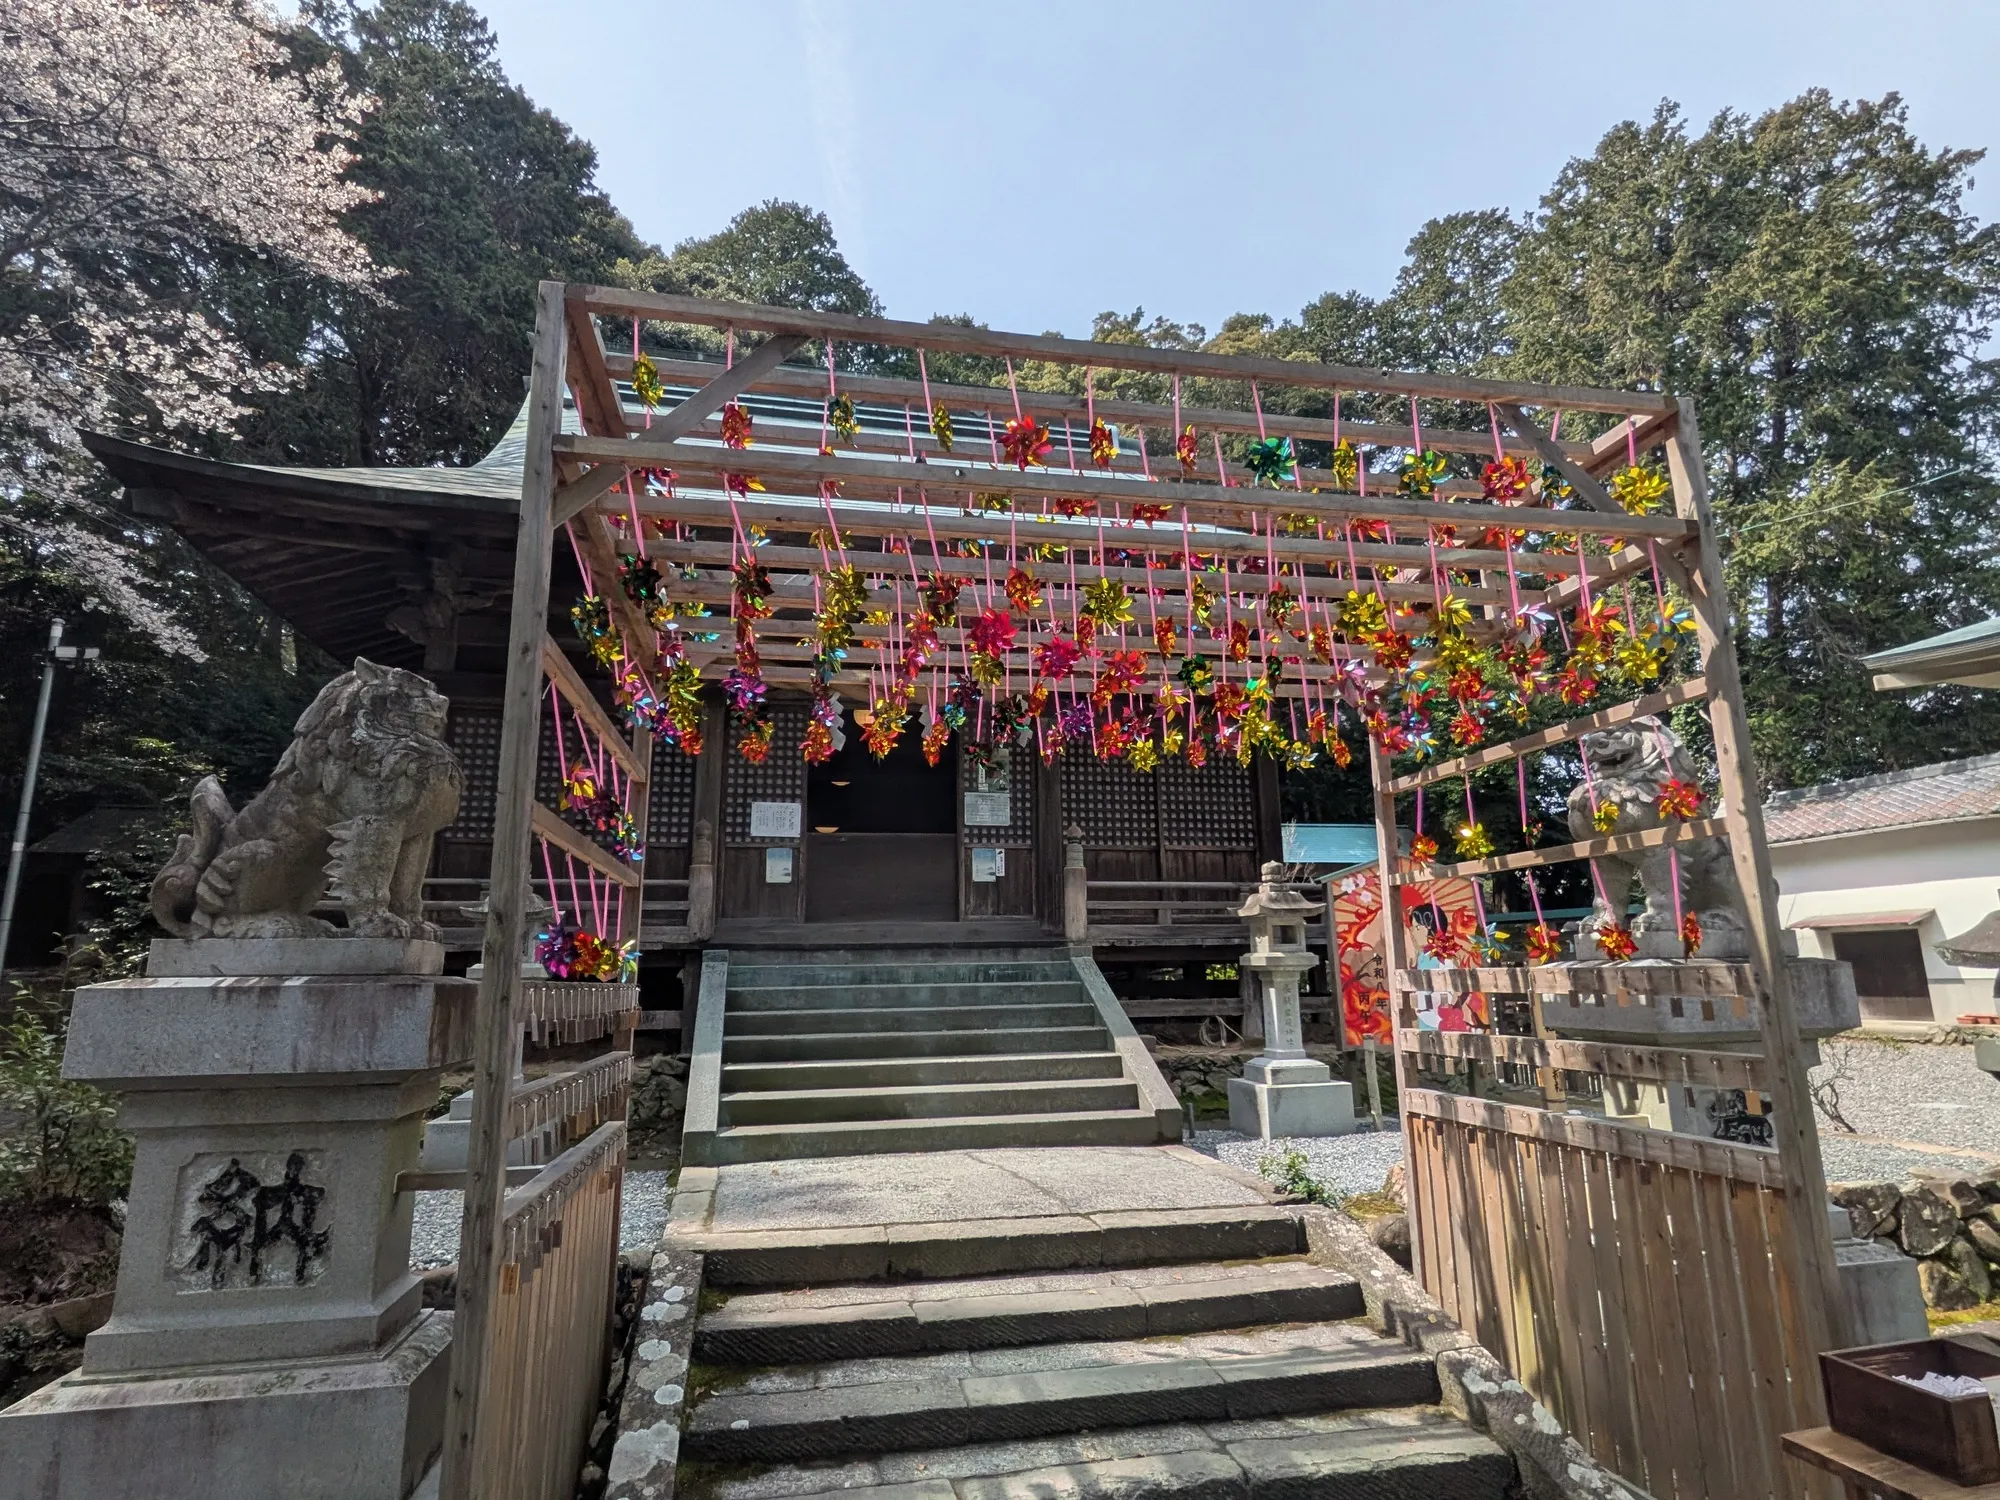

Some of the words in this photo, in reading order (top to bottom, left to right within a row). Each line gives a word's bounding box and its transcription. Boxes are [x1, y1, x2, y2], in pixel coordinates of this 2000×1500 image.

[1373, 954, 1387, 1009] 令和八年
[1359, 992, 1371, 1024] 丙午
